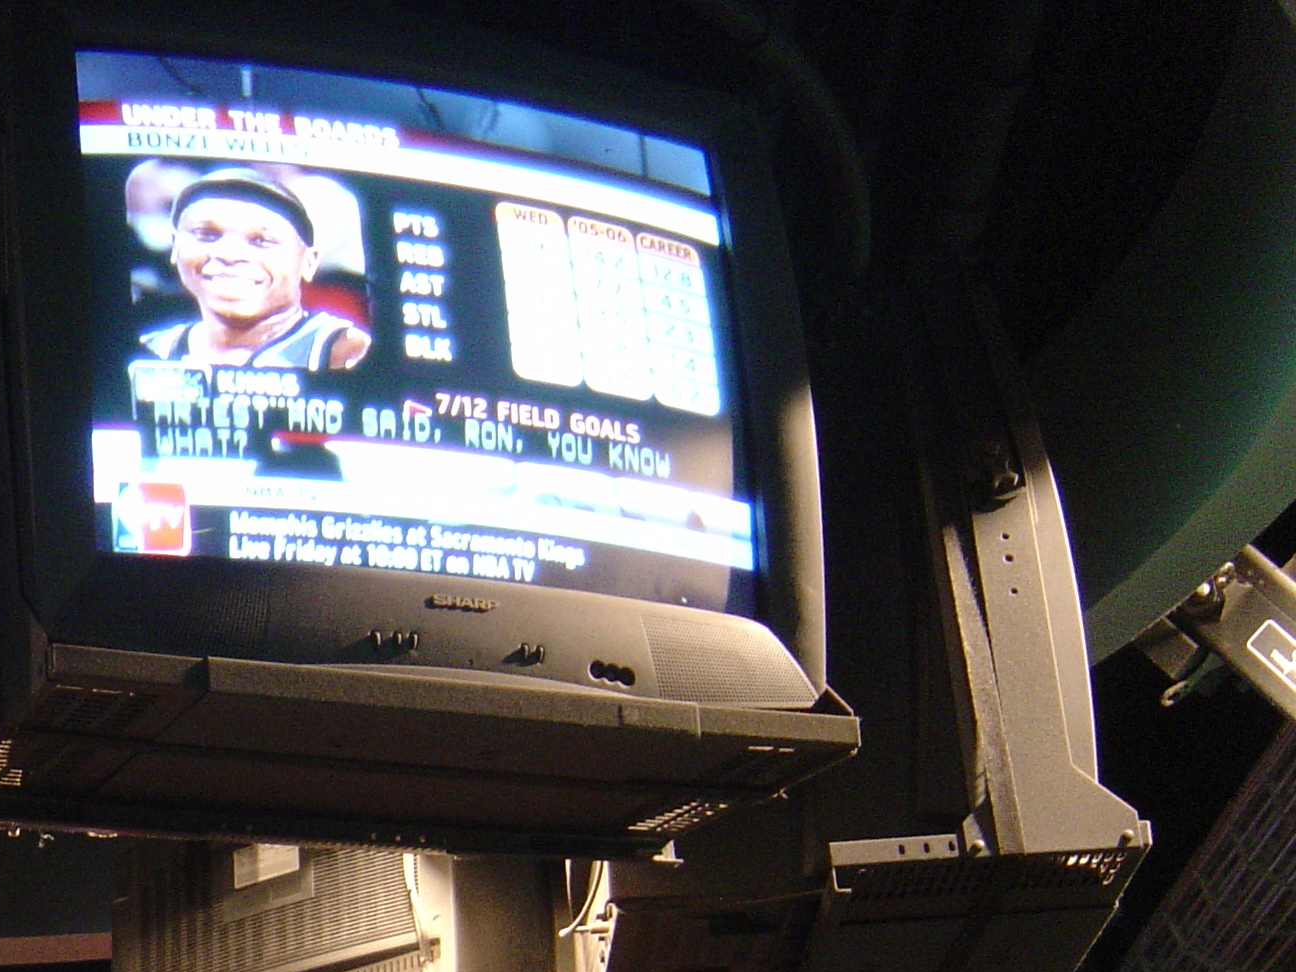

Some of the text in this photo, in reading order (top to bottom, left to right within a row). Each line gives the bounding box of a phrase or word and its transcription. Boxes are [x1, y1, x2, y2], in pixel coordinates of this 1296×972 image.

[121, 103, 217, 130] UNDER
[228, 109, 283, 134] THE
[128, 131, 208, 150] BONZI
[393, 211, 440, 238] PTS
[513, 207, 549, 226] WED
[572, 220, 628, 244] '05-06
[640, 236, 693, 262] CAREER
[400, 270, 446, 298] AST
[403, 302, 448, 330] STL
[435, 392, 641, 446] 7/12 FIELD GOALS
[156, 427, 249, 459] WHAT?
[547, 430, 593, 466] YOU
[608, 442, 671, 480] KNOW
[229, 536, 271, 560] Live
[274, 534, 338, 567] Friday
[340, 544, 362, 566] at
[512, 557, 536, 582] TV
[406, 525, 427, 547] at
[537, 537, 586, 570] Kings
[431, 594, 500, 612] SHARP
